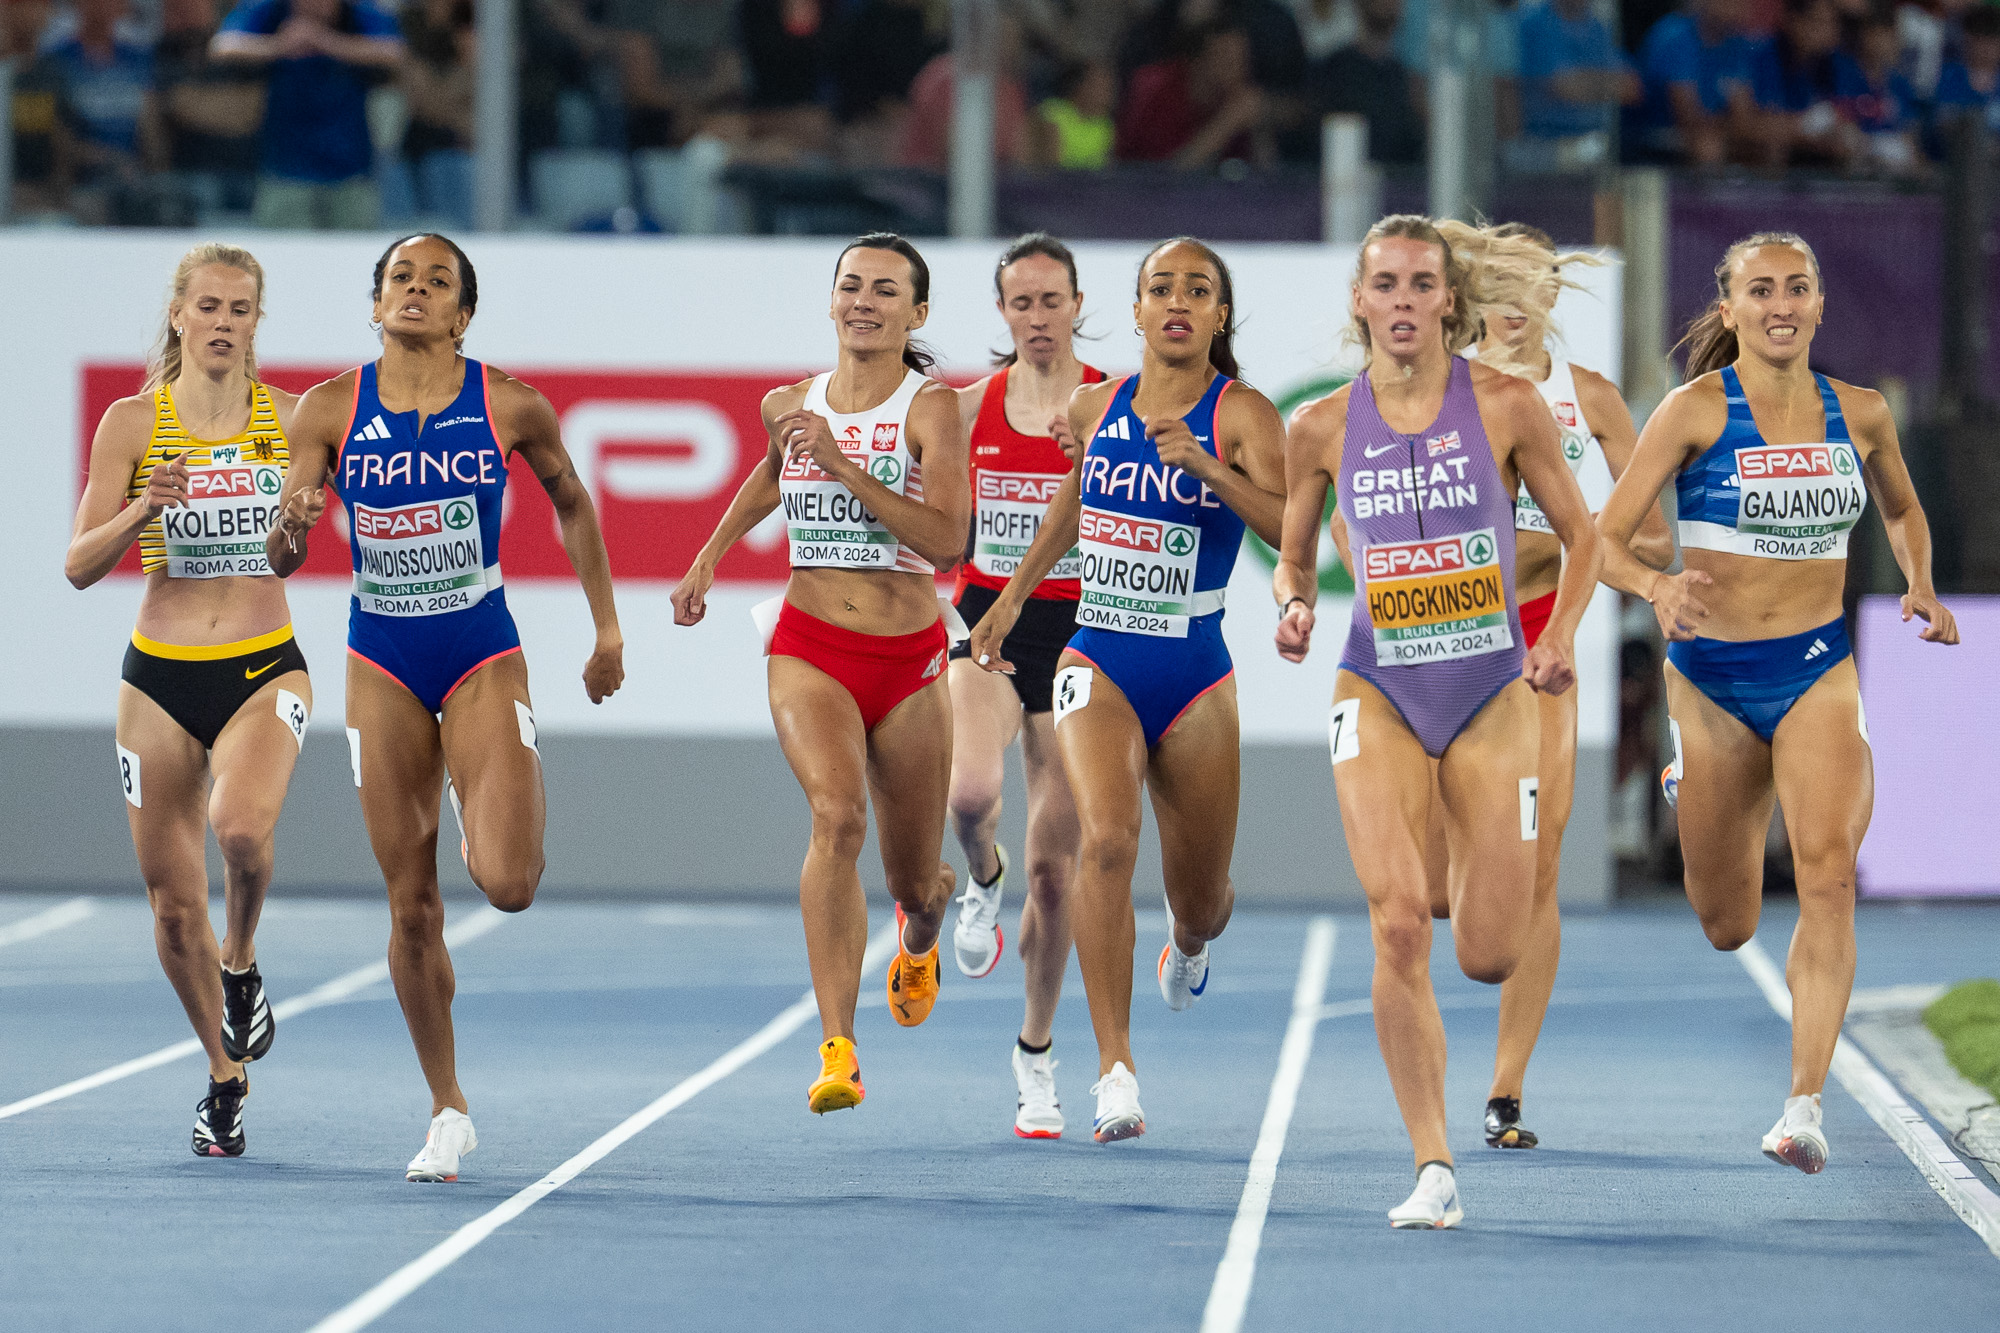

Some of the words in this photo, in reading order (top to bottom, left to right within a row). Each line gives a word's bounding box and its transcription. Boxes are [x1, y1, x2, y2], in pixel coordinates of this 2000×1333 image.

[836, 441, 859, 449] RLEN
[345, 449, 497, 489] FRANCE
[1741, 450, 1832, 476] SPAR
[187, 472, 255, 496] PAR
[1352, 456, 1470, 494] GREAT
[1353, 484, 1478, 520] BRITAIN
[1744, 481, 1861, 520] GAJANOVÁ
[357, 506, 440, 536] SPAR
[1080, 512, 1161, 549] SPAR
[1772, 526, 1800, 537] RUN
[1801, 524, 1834, 537] CLEAN
[805, 530, 830, 541] RUN
[833, 531, 869, 543] CLEAN
[1754, 538, 1806, 556] ROMA
[1809, 535, 1838, 555] 2024
[197, 545, 222, 556] RUN
[225, 543, 264, 554] CLEAN
[796, 546, 841, 561] ROMA
[843, 547, 881, 562] 2024
[1367, 544, 1462, 576] SPAR
[185, 559, 234, 575] ROMA
[238, 557, 270, 572] 202
[1047, 562, 1081, 576] 024
[384, 585, 410, 596] RUN
[412, 581, 454, 594] CLEAN
[1370, 575, 1499, 623] HODGKINSON
[373, 598, 424, 613] ROMA
[427, 591, 470, 612] 2024
[1087, 592, 1115, 607] RUN
[1116, 597, 1158, 612] CLEAN
[1126, 615, 1169, 633] 2024
[1403, 626, 1432, 640] RUN
[1436, 619, 1478, 636] CLEAN
[1394, 642, 1447, 660] ROMA
[1450, 632, 1494, 654] 2024
[1333, 711, 1345, 755] 7
[121, 755, 132, 795] 8
